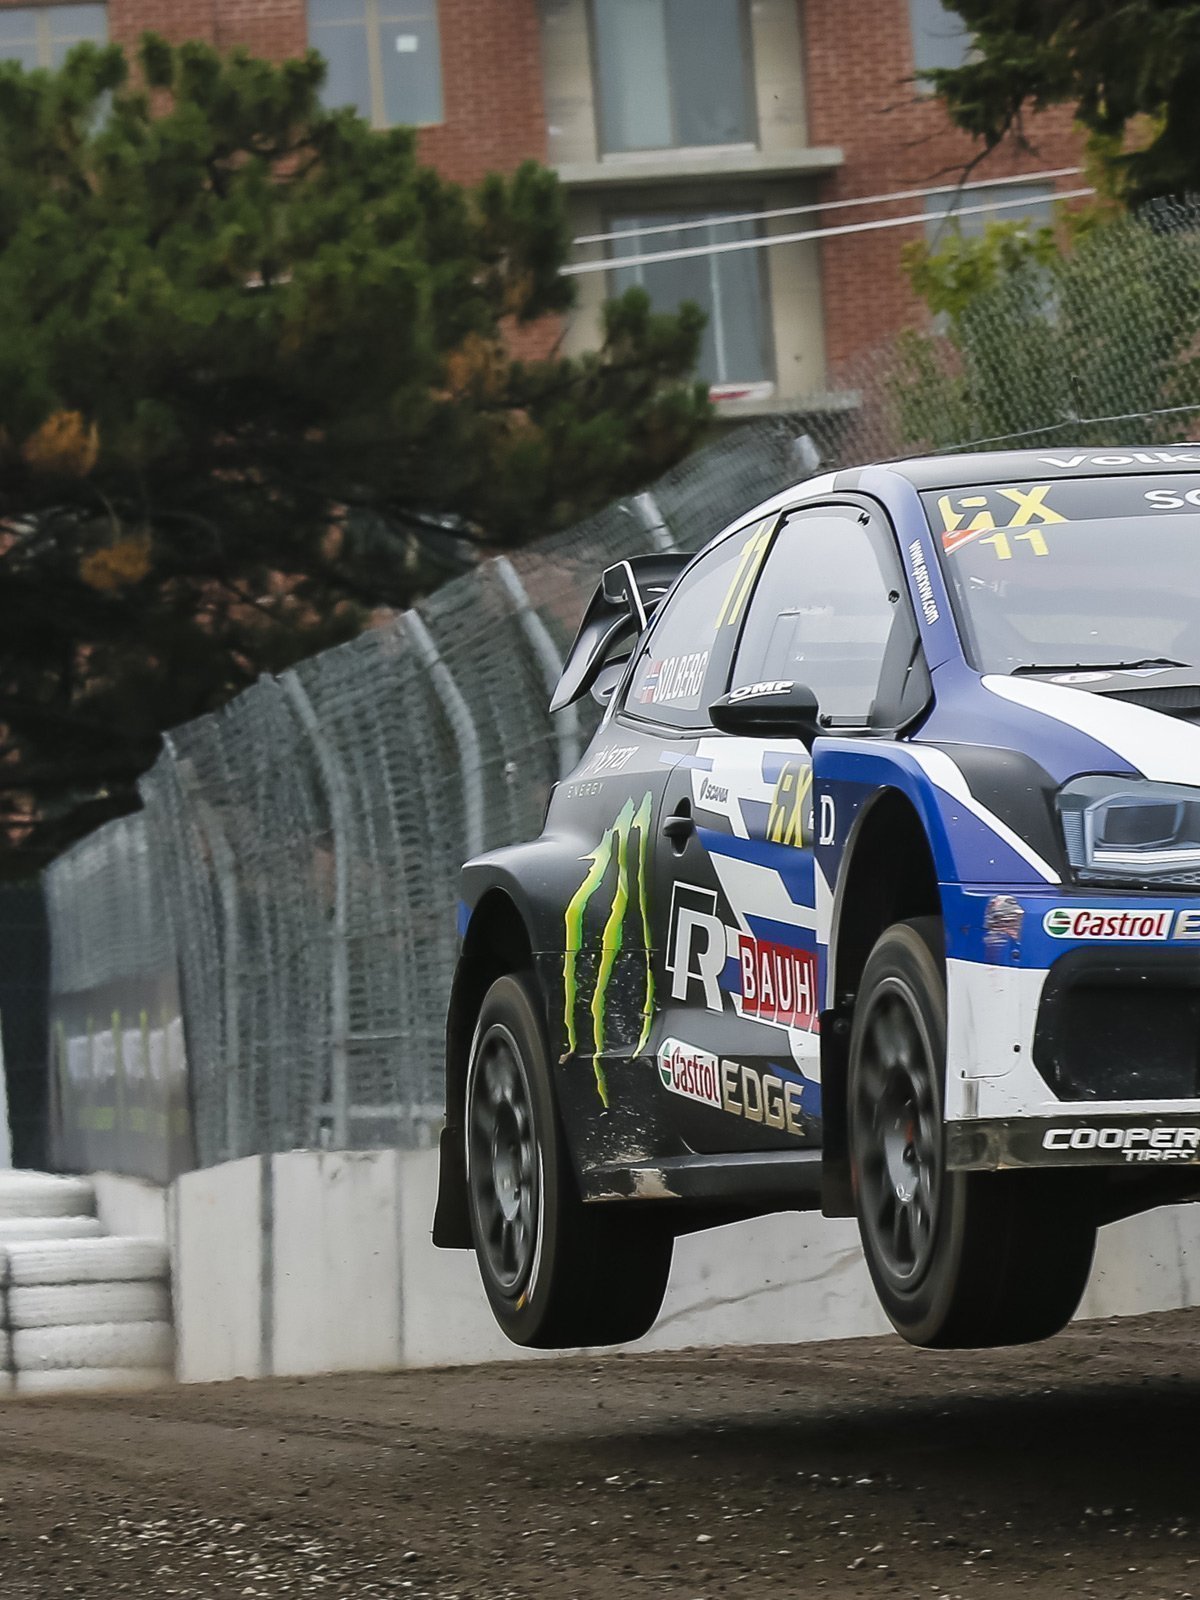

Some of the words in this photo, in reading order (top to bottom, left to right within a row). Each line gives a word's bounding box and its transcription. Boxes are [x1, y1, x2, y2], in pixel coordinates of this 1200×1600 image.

[979, 528, 1049, 560] 11
[716, 507, 784, 630] 11
[653, 650, 709, 703] SOLBERG
[730, 681, 794, 699] OMP
[567, 781, 605, 799] ENERGY
[705, 784, 729, 803] SCANIA
[1073, 911, 1165, 936] Castrol
[670, 902, 728, 1012] R
[741, 946, 819, 1018] BAUH
[671, 1047, 719, 1103] Castrol
[721, 1060, 805, 1136] EDGE
